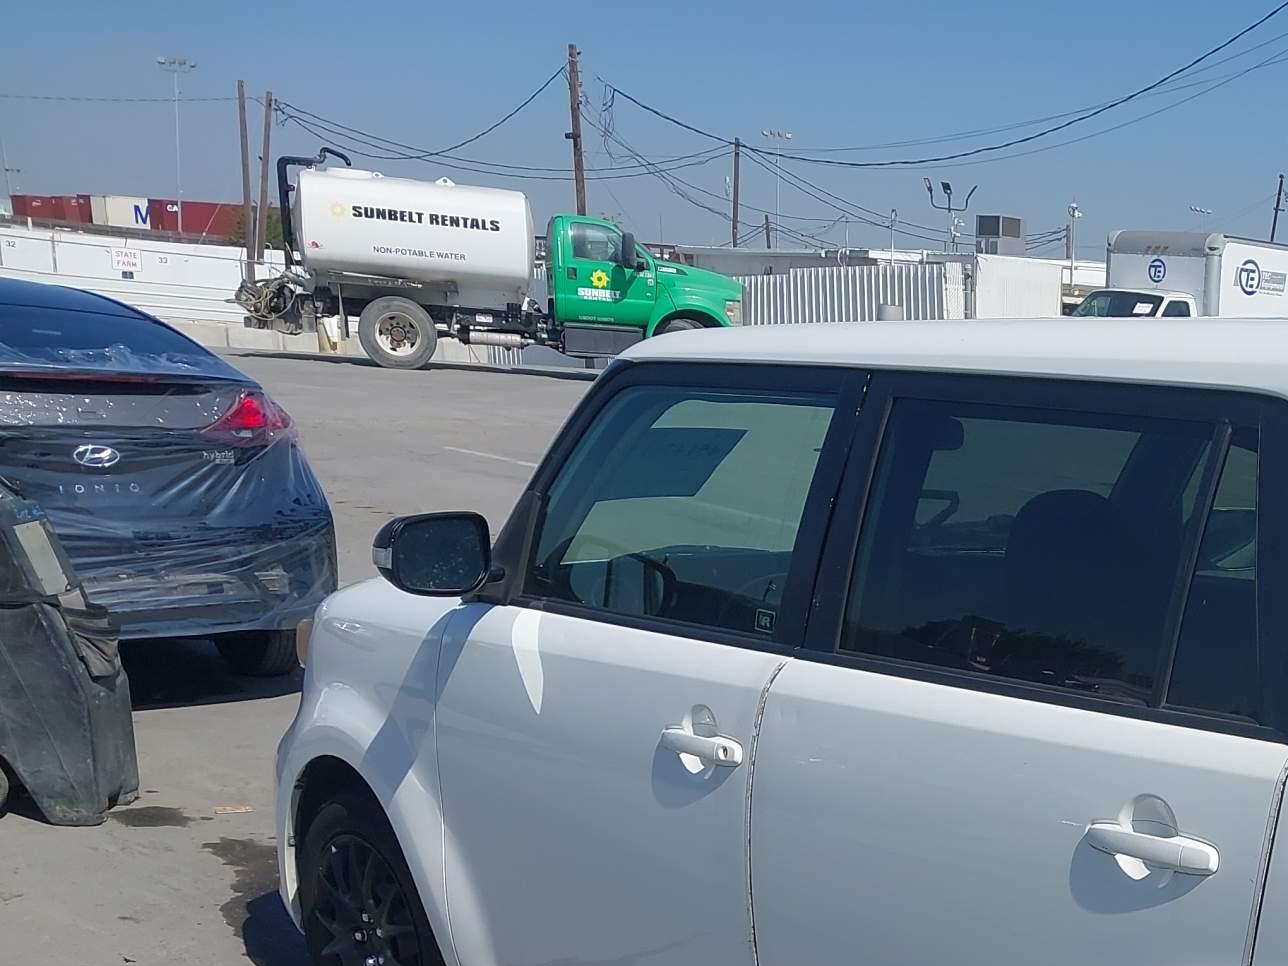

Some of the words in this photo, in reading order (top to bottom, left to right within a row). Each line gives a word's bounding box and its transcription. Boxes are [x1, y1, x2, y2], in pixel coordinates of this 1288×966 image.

[352, 205, 424, 224] SUNBELT
[429, 213, 501, 232] RENTALS
[5, 240, 16, 248] 32
[115, 250, 137, 259] STATE
[373, 246, 435, 259] NON-POTABLE
[436, 252, 466, 261] WATER
[117, 259, 137, 268] FARM
[577, 287, 621, 299] SUNBELT
